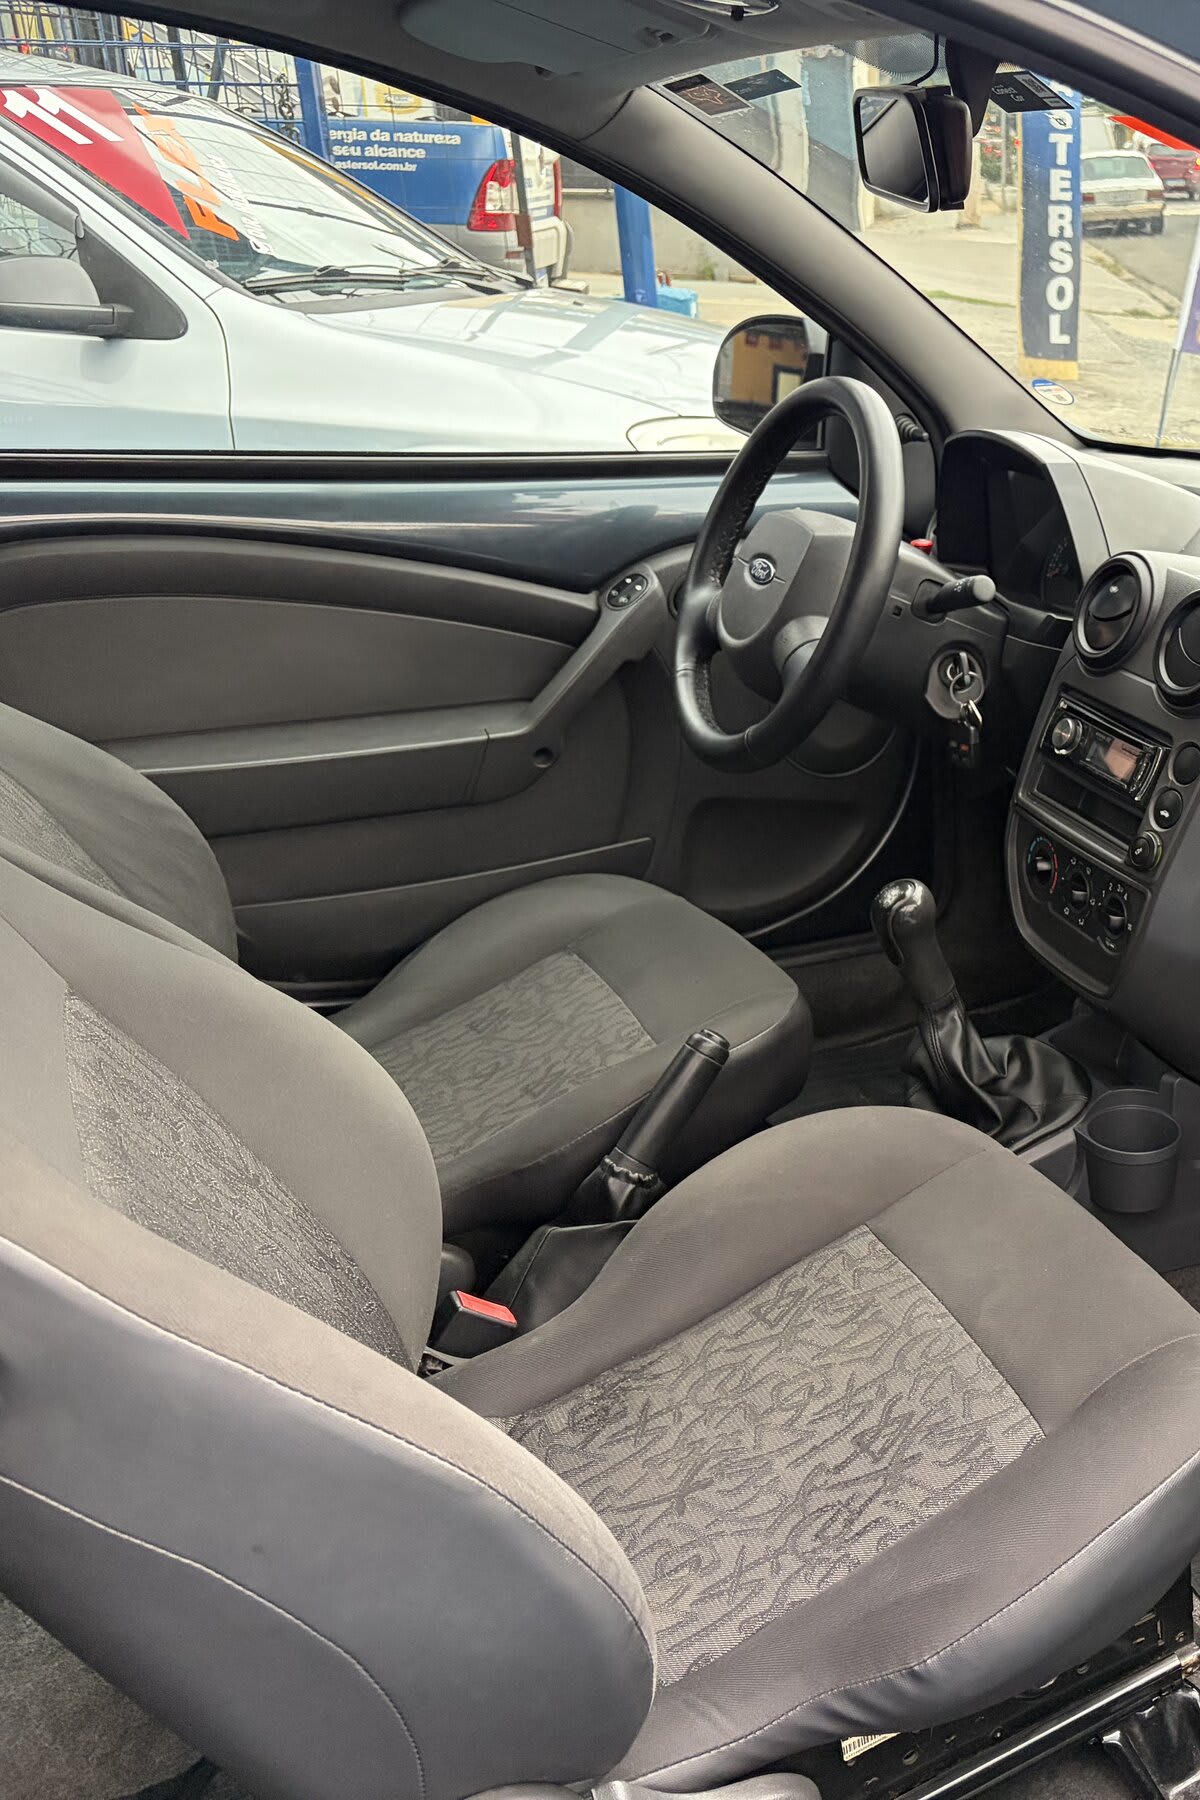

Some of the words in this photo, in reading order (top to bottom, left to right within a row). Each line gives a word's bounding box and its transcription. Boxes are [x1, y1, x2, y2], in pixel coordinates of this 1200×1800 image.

[370, 129, 390, 142] da
[393, 131, 461, 144] natureza
[332, 145, 361, 156] seu
[364, 144, 426, 158] alcance
